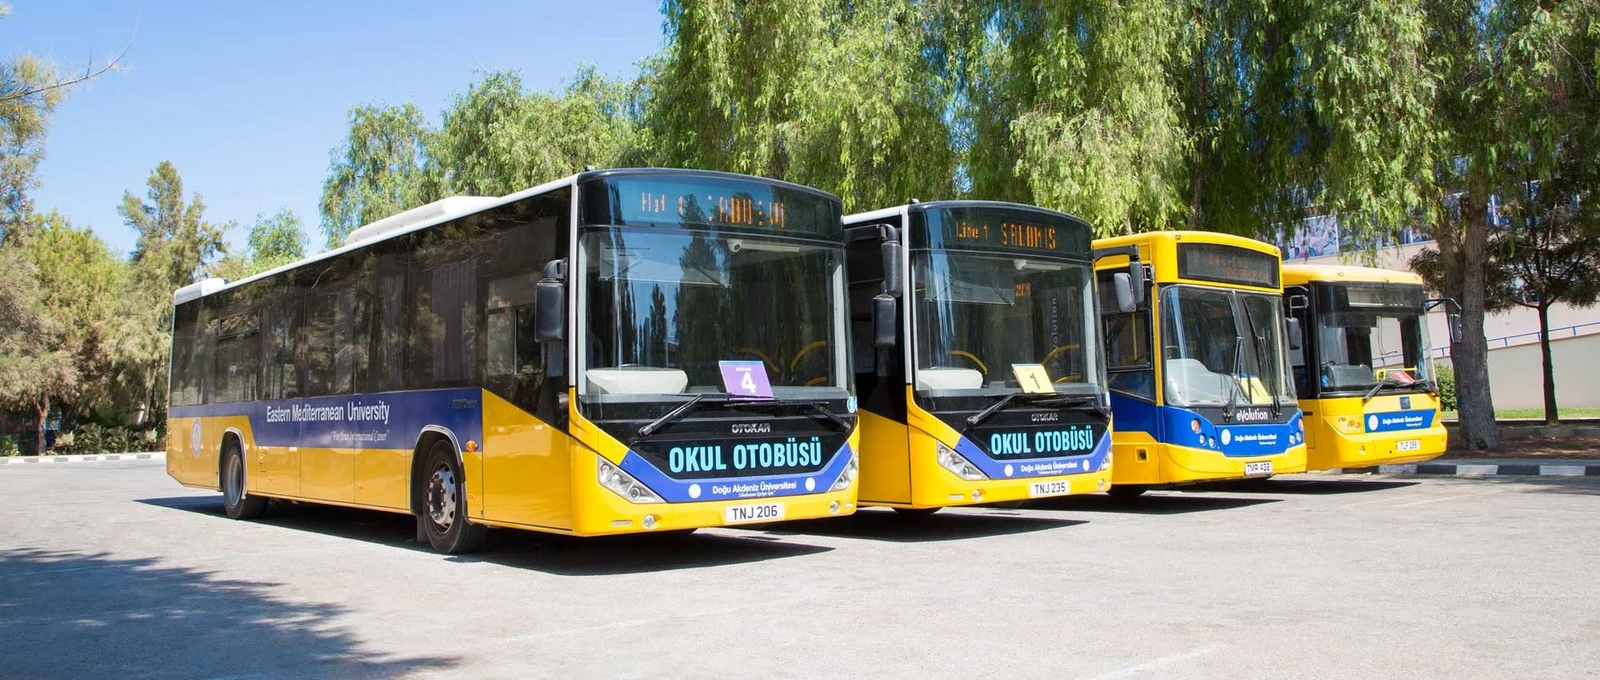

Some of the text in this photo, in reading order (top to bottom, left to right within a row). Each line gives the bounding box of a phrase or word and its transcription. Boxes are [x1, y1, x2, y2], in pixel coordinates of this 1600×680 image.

[741, 372, 757, 393] 4
[1029, 373, 1040, 390] 1
[266, 400, 390, 425] Eastern Mediterranean University
[731, 423, 771, 434] OTOKAR
[990, 424, 1093, 455] OKUL OTOBÜSÜ
[669, 436, 822, 473] OKUL OTOBÜSÜ
[712, 485, 732, 496] Doğu
[732, 484, 759, 493] Akdeniz
[760, 481, 797, 492] Üniversitesi
[1034, 482, 1066, 495] TNJ 235
[732, 505, 778, 520] TNJ 206
